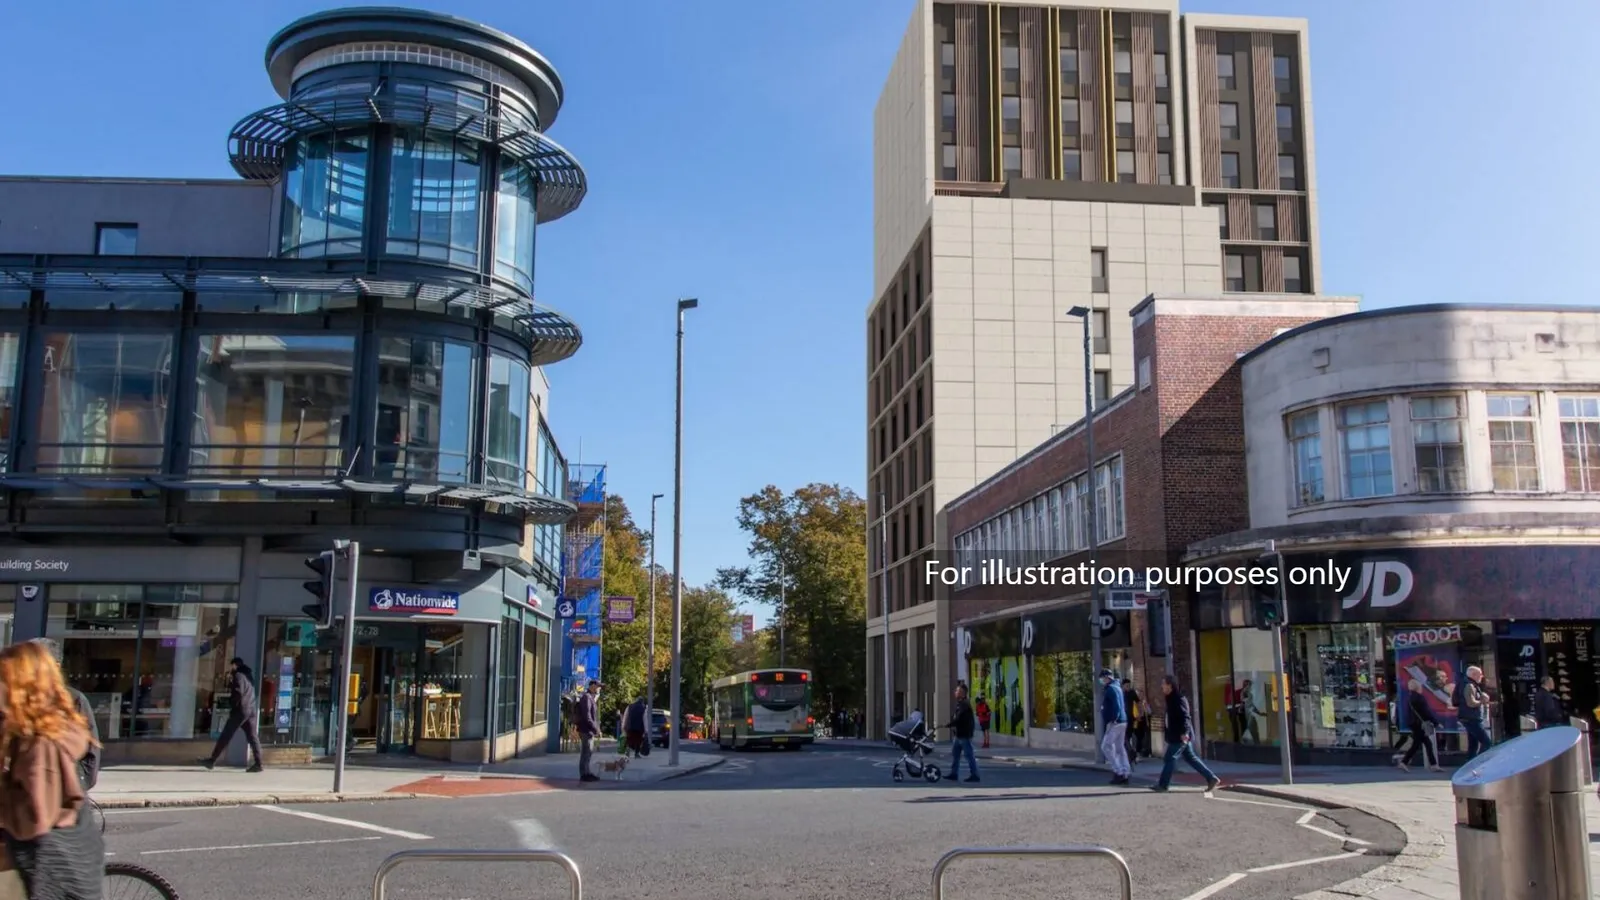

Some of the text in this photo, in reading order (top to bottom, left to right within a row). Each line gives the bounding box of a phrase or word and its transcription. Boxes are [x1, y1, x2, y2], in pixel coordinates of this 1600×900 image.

[35, 560, 69, 571] Society
[1341, 560, 1414, 610] JD
[395, 592, 457, 609] Nationwide
[1543, 631, 1563, 644] MEN
[1519, 644, 1535, 657] JD
[1575, 630, 1589, 661] MEN
